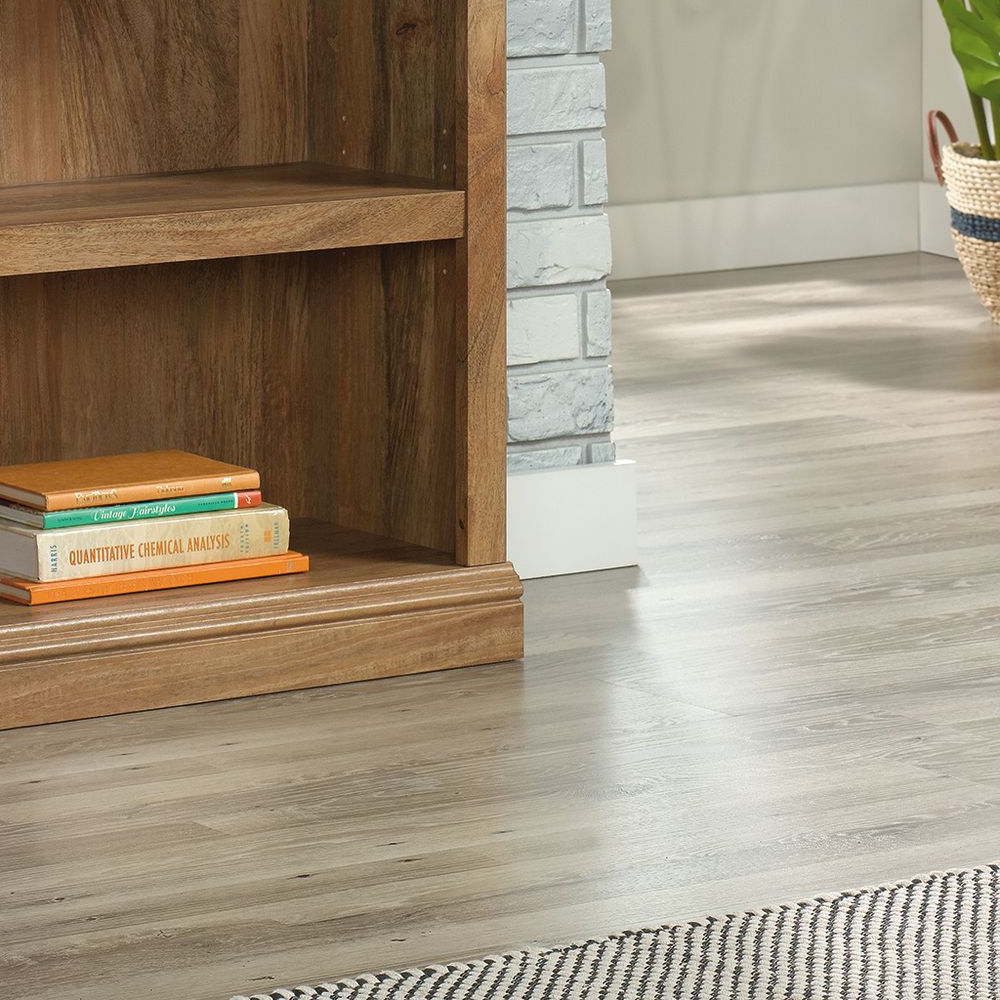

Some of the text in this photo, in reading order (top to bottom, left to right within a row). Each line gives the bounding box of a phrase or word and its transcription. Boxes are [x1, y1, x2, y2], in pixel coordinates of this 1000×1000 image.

[90, 509, 127, 521] Vintage
[127, 503, 176, 519] Hairstyles
[49, 544, 58, 573] HARRIS
[68, 543, 135, 566] QUANTITATIVE
[137, 538, 184, 558] CHEMICAL
[186, 533, 230, 553] ANALYSIS
